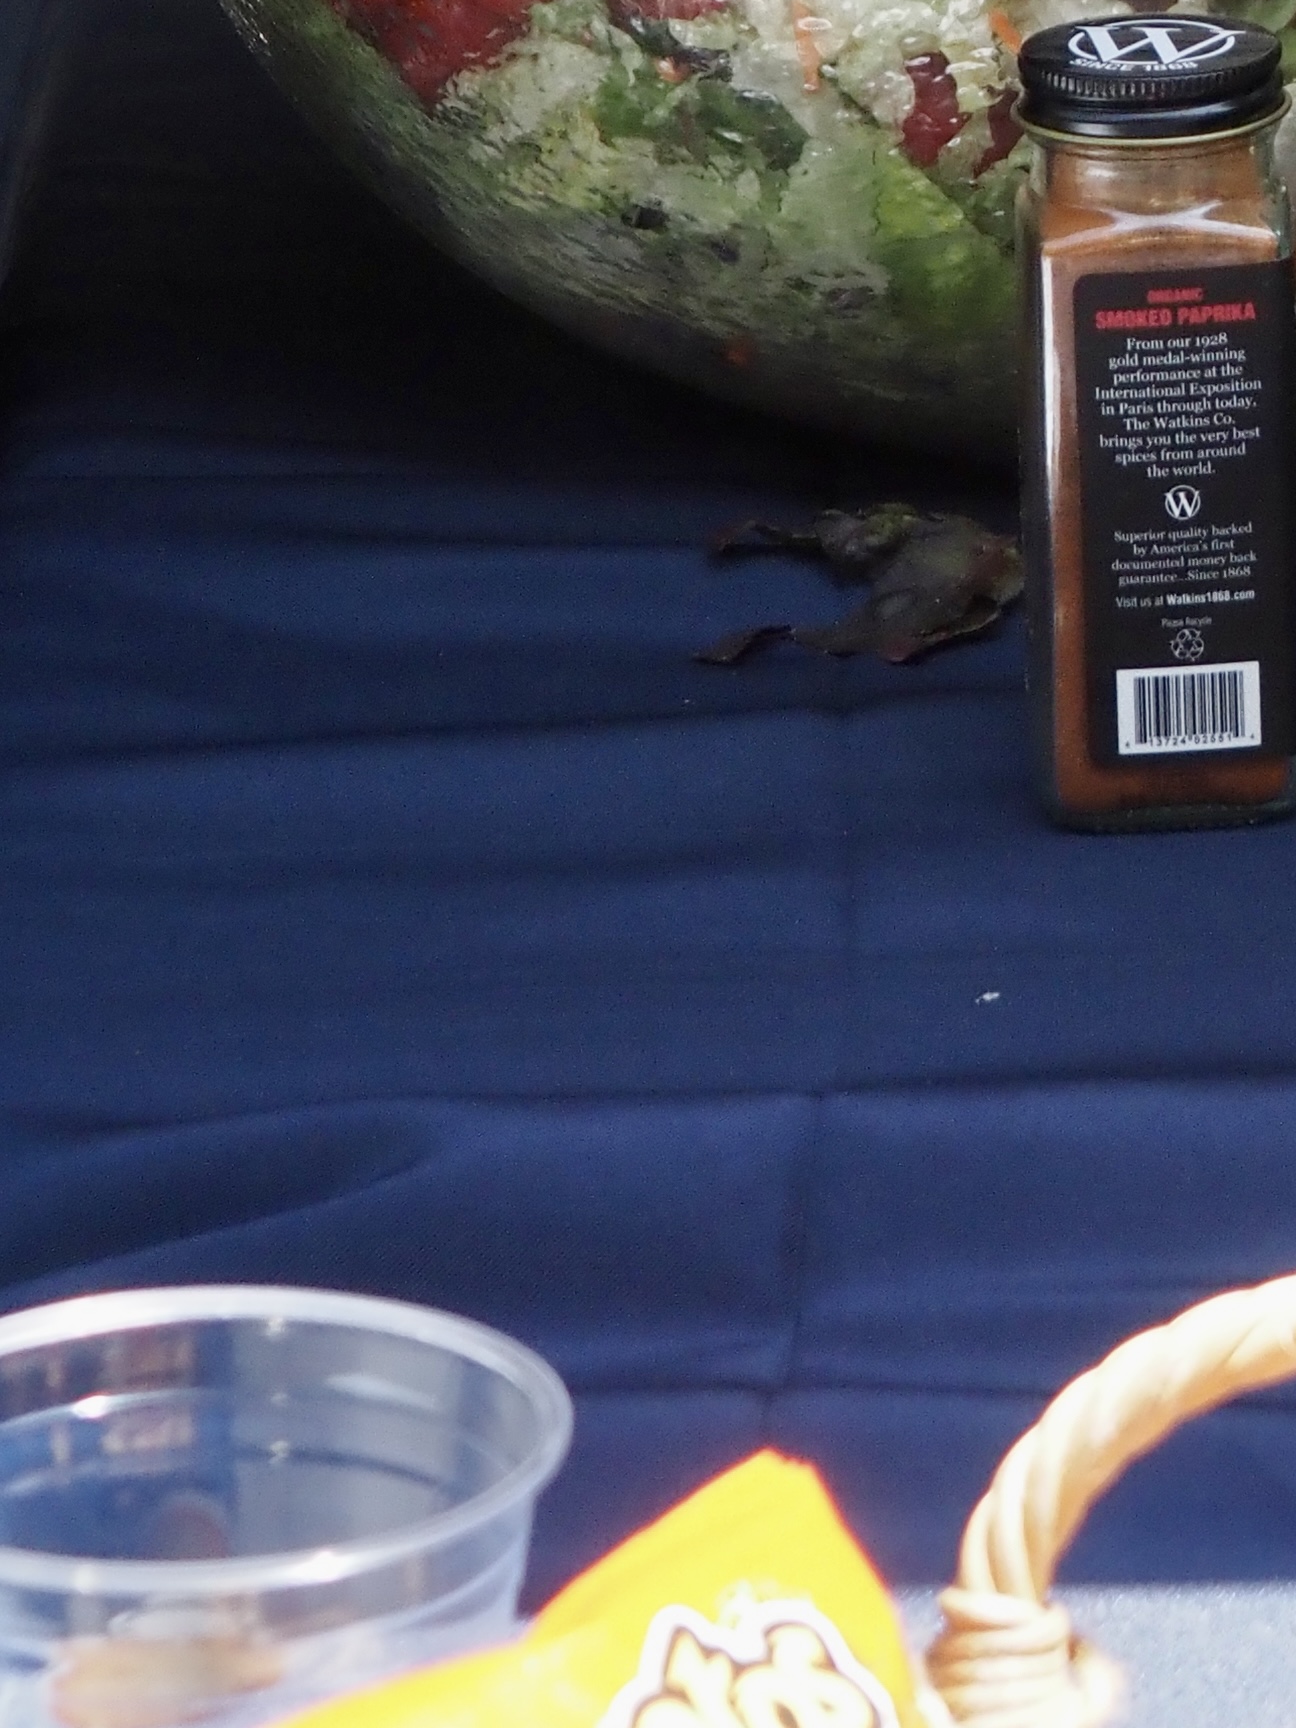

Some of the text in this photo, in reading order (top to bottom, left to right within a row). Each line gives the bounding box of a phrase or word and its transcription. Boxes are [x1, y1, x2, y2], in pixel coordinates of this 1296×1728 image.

[1075, 25, 1247, 65] W
[1068, 57, 1199, 72] SINCE 1868
[1146, 287, 1203, 304] ORGANIC
[1095, 301, 1257, 330] SMOKED PAPRIKA
[1126, 332, 1228, 351] From our 1928
[1108, 347, 1247, 370] gold medal-winning
[1113, 362, 1244, 387] performance at the
[1095, 378, 1262, 401] International Exposition
[1101, 402, 1115, 416] in
[1118, 401, 1154, 416] Paris
[1157, 396, 1212, 414] through
[1123, 412, 1236, 431] The Watkins Co.
[1100, 426, 1261, 449] brings you the very best
[1115, 441, 1247, 466] spices from around
[1147, 461, 1216, 478] the world.
[1164, 490, 1200, 518] W
[1114, 521, 1253, 544] Superior quality backed
[1133, 538, 1235, 558] by America's first
[1111, 550, 1257, 571] documented money back
[1222, 565, 1251, 580] 1868
[1115, 589, 1256, 609] Visit us at Watkins1868.com
